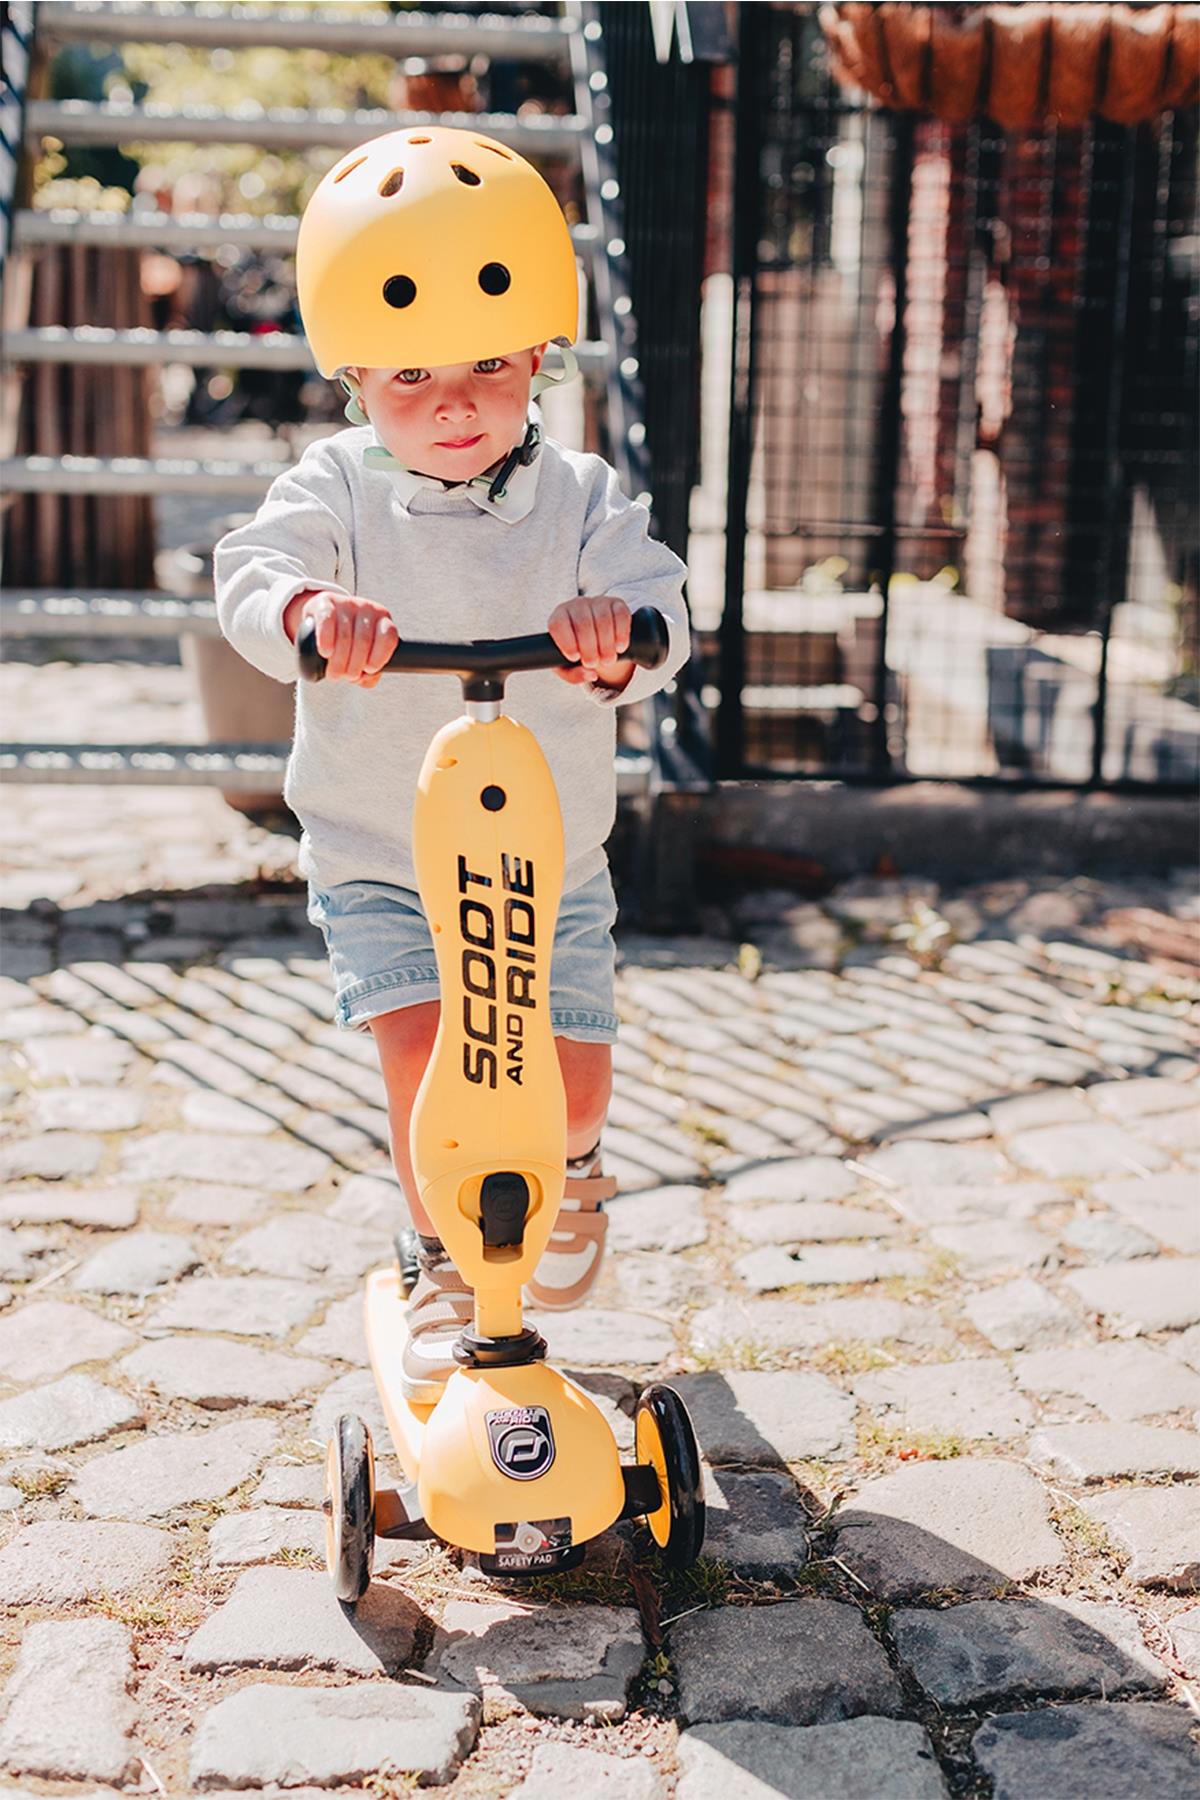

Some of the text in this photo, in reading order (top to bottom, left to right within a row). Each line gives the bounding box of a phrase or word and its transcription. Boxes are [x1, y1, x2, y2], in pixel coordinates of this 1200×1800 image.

[457, 855, 497, 1089] SCOOT
[501, 853, 536, 1086] AND RIDE
[498, 1556, 533, 1567] SAFETY
[534, 1554, 552, 1565] PAD
